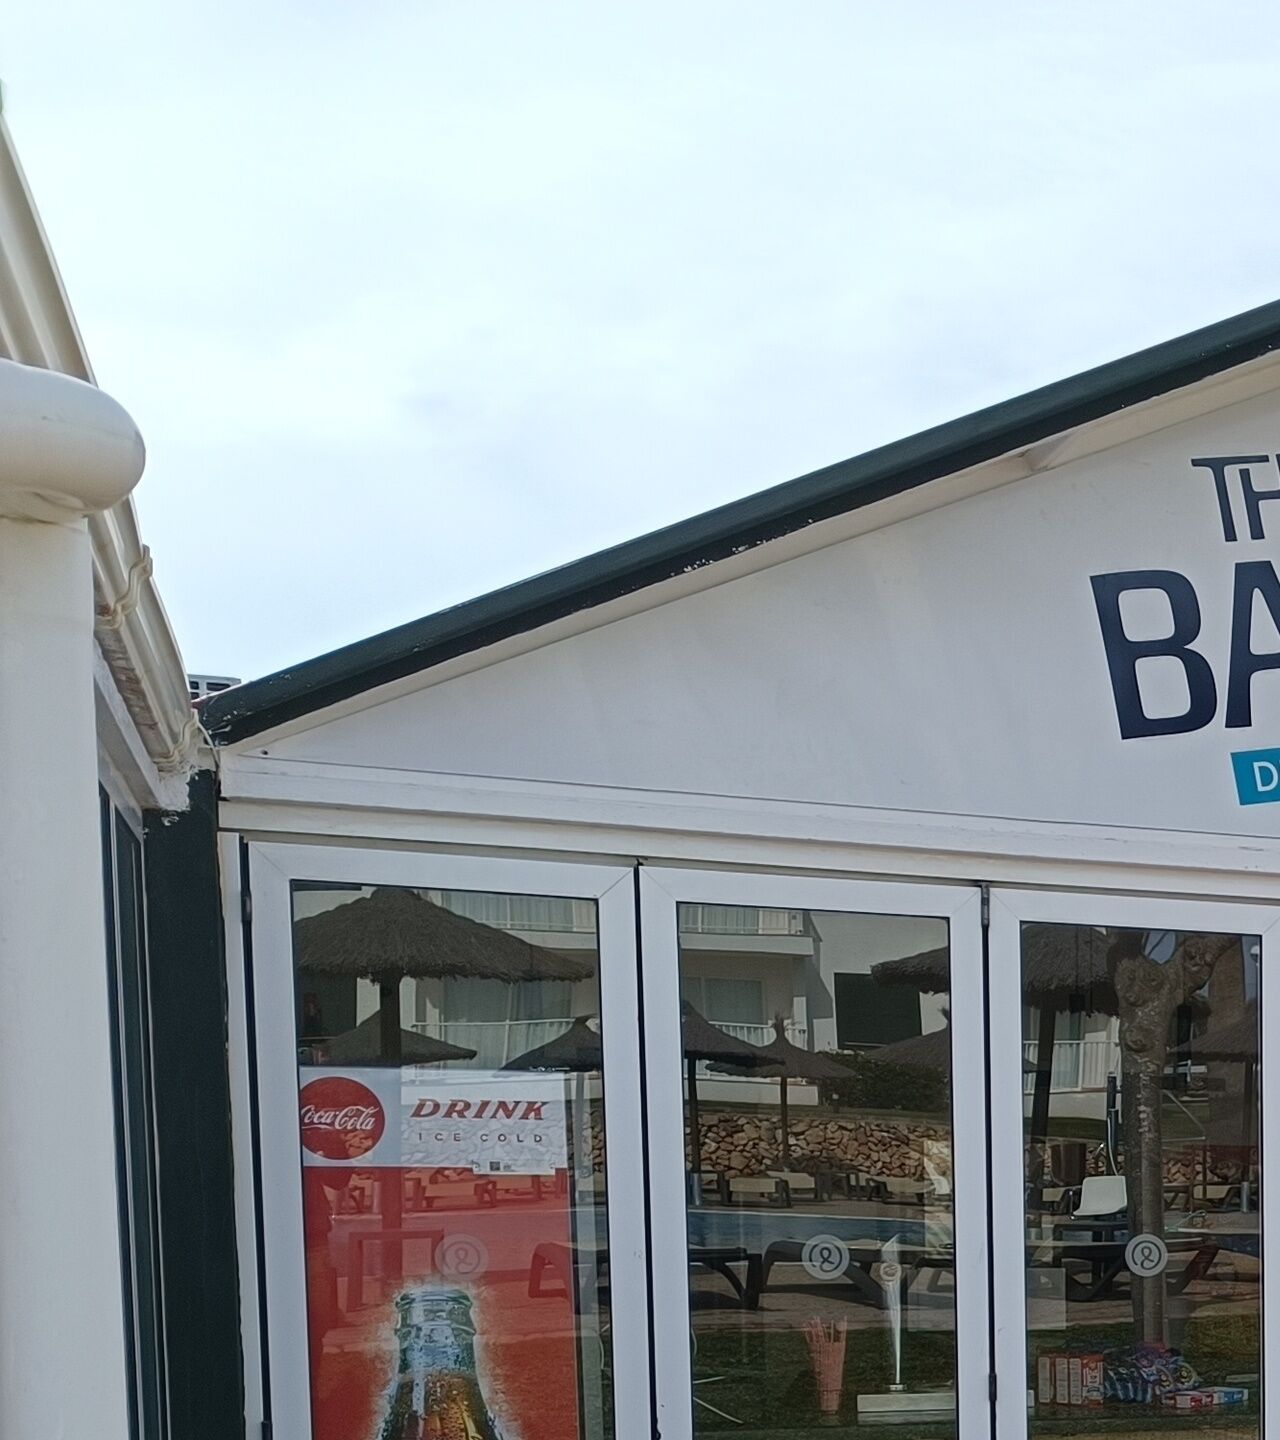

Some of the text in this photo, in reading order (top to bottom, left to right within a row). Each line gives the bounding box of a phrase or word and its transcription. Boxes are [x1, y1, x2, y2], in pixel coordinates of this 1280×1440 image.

[301, 1105, 380, 1131] Coca-Cola
[410, 1098, 549, 1121] DRINK
[418, 1132, 543, 1144] ICE COLD
